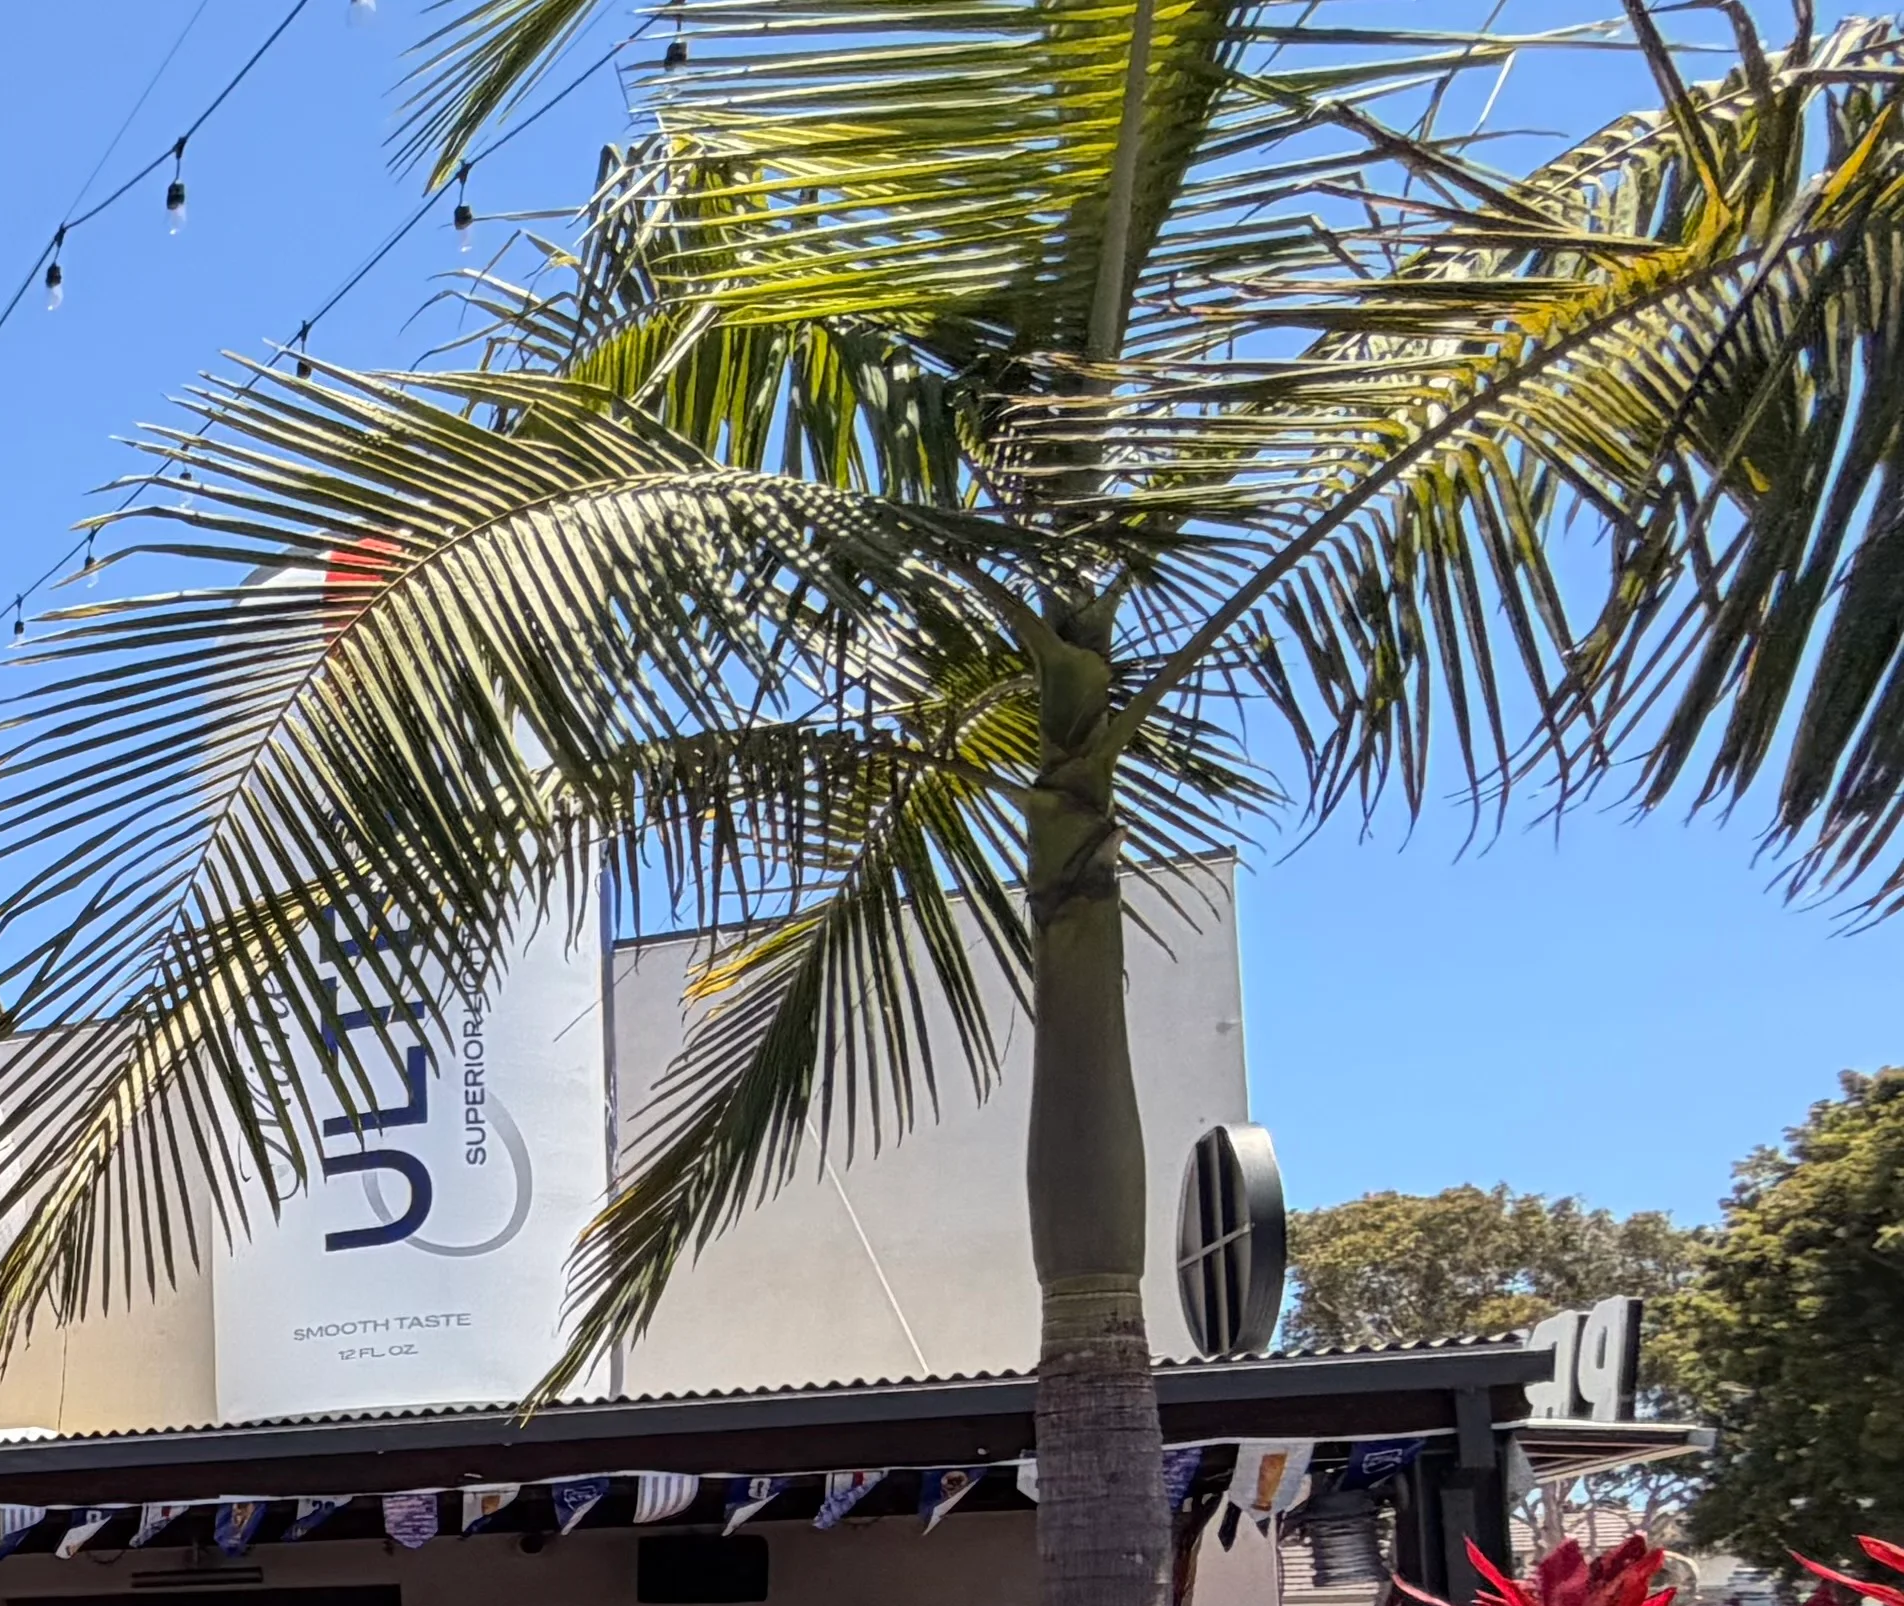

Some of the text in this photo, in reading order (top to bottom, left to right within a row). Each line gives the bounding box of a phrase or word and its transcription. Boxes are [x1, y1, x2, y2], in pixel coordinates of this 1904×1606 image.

[464, 1020, 488, 1166] SUPERIOR
[293, 1312, 473, 1342] SMOOTH TASTE
[338, 1344, 419, 1361] 12 FL OZ
